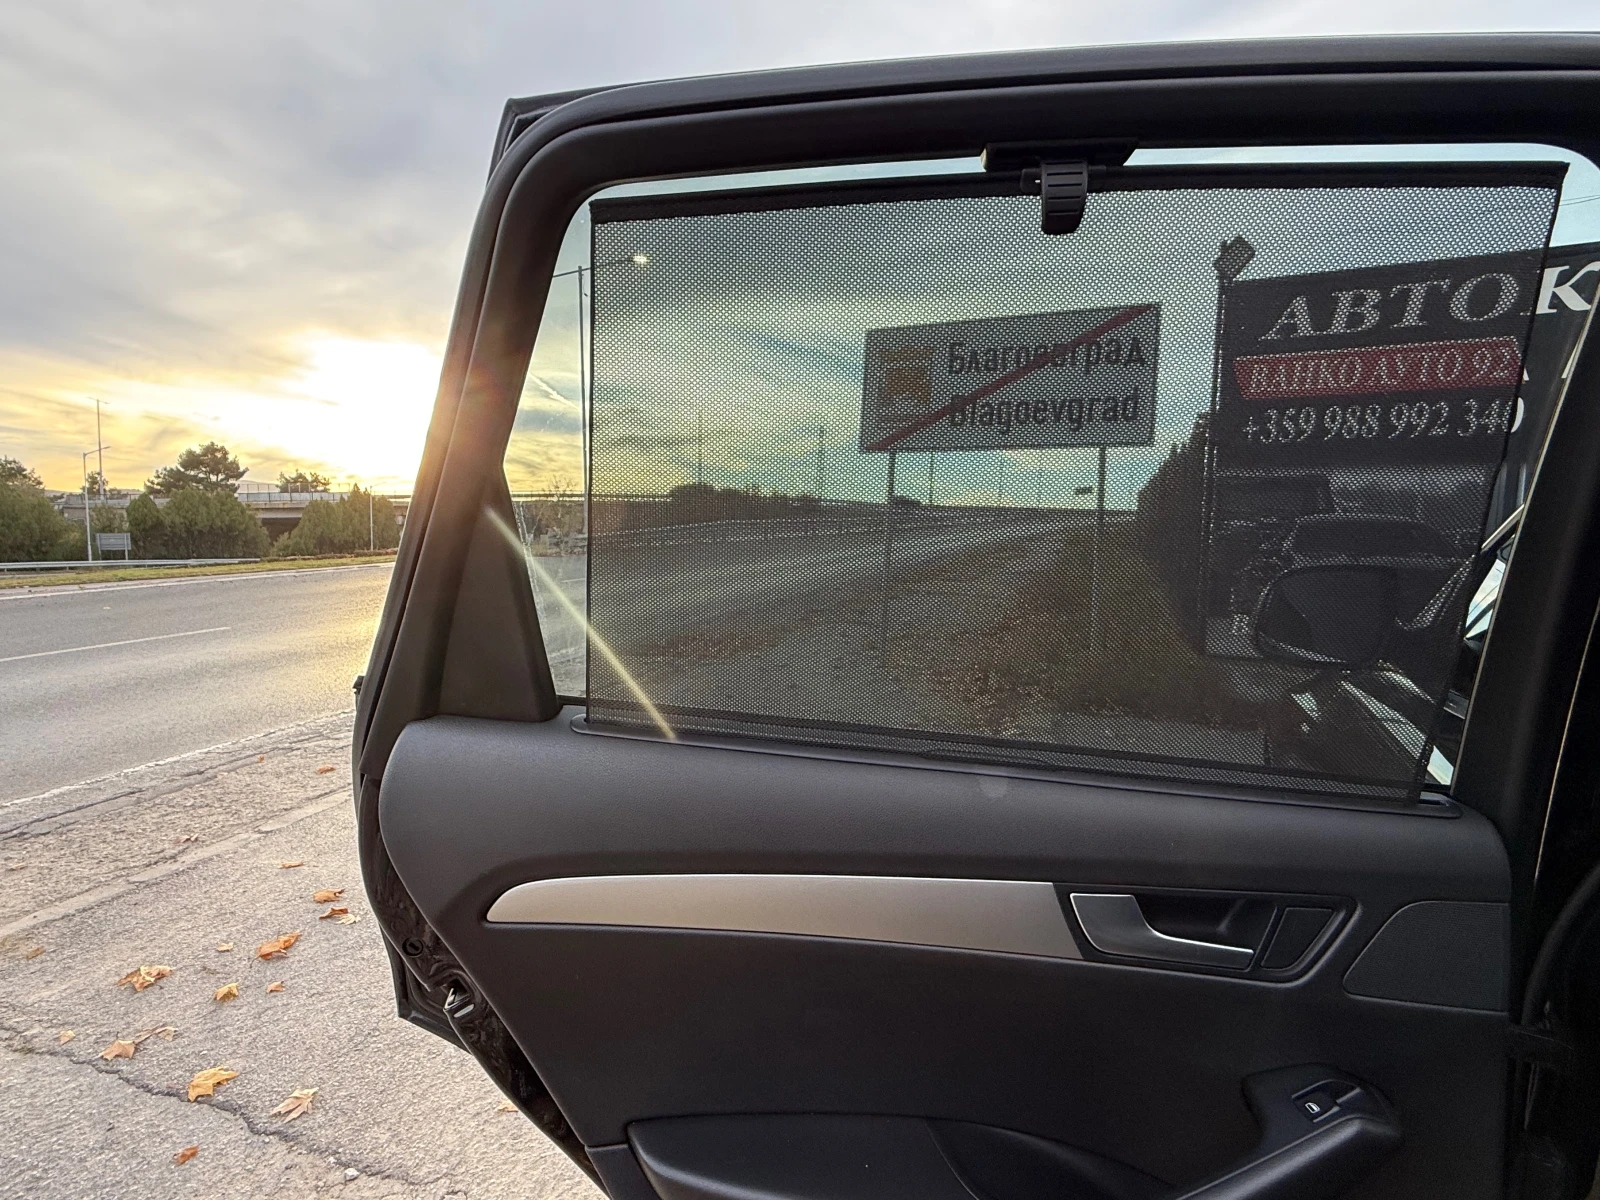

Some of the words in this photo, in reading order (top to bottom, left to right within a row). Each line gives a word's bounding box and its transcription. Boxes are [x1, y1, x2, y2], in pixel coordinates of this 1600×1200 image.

[948, 337, 1146, 376] Благоевград
[1472, 346, 1513, 381] 92
[949, 386, 1140, 435] Blagoevgrad
[1242, 405, 1317, 444] +359
[1323, 402, 1382, 441] 988
[1387, 398, 1450, 440] 992
[1457, 396, 1526, 437] 340
